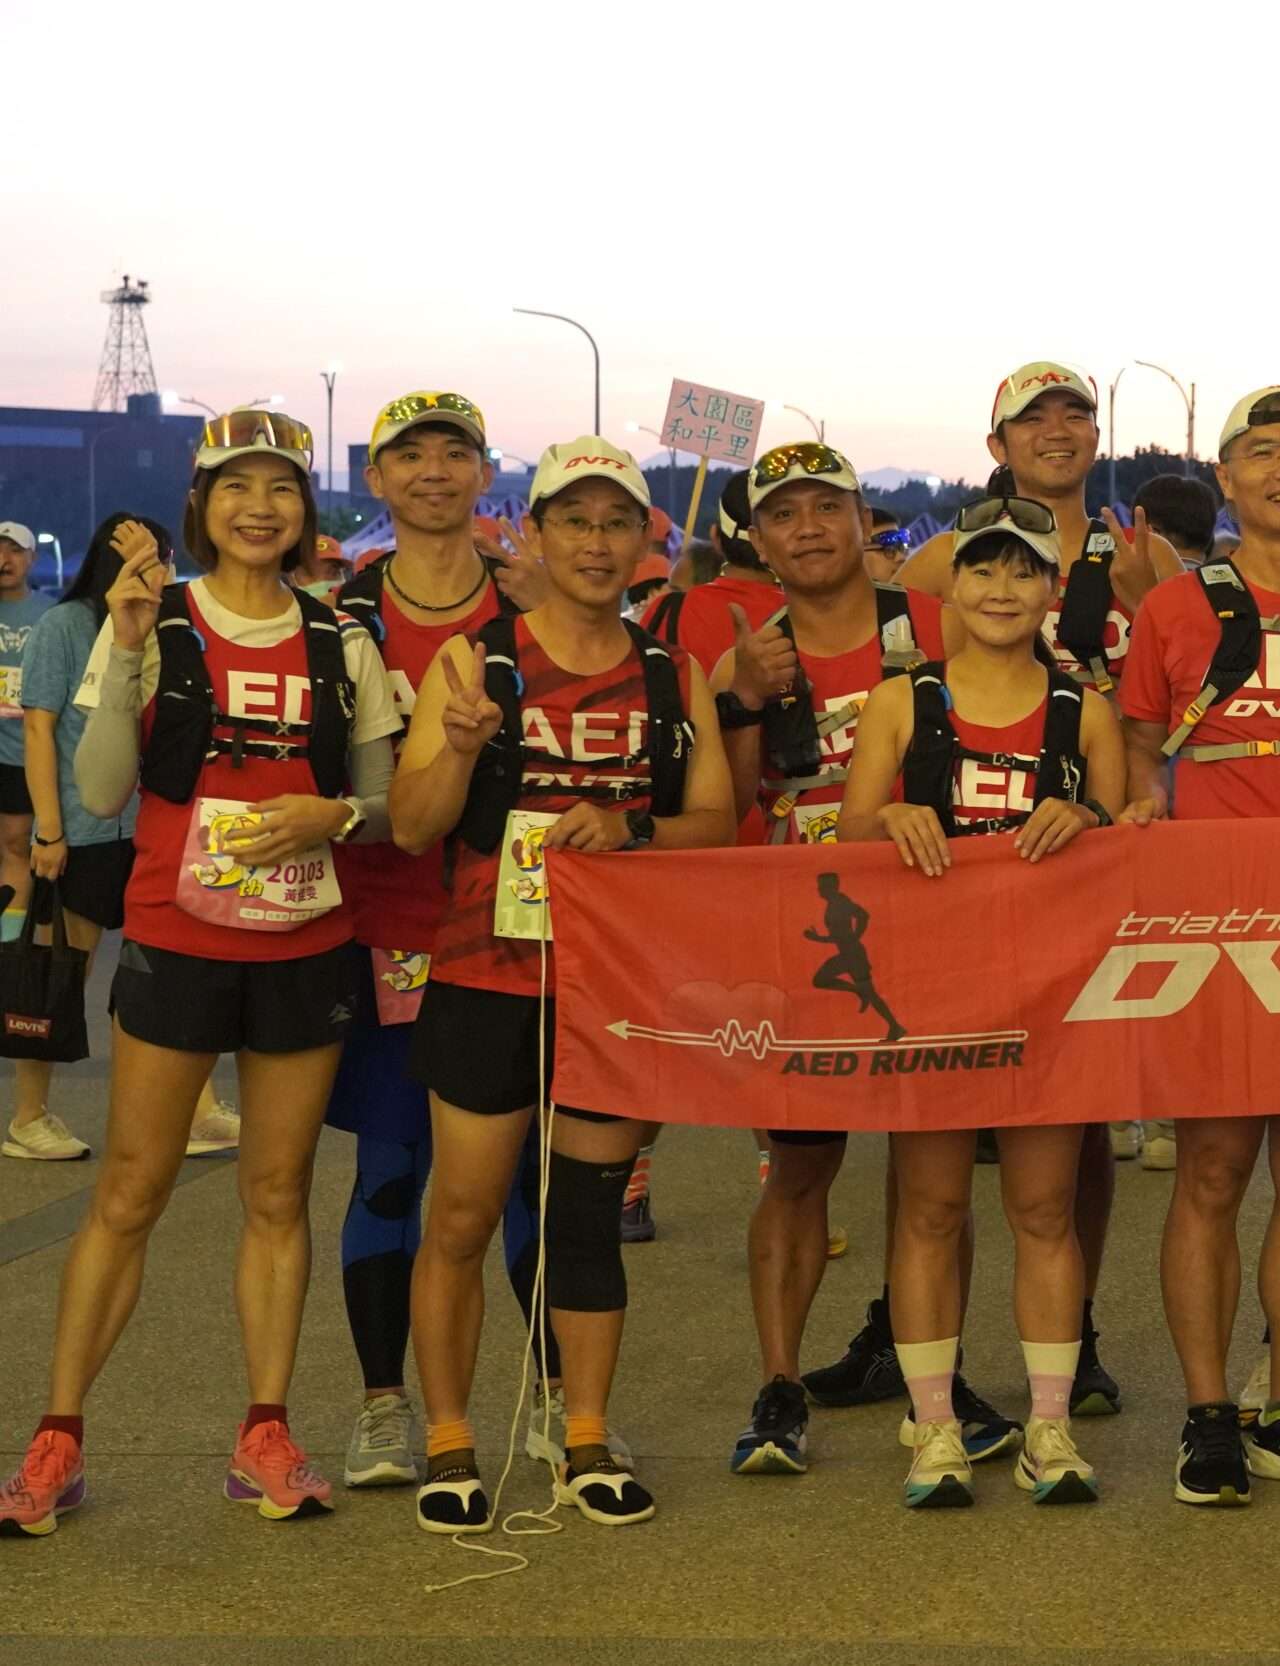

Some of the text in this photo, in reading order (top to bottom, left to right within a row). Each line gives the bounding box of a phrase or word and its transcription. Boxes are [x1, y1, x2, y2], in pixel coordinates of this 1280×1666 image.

[674, 388, 756, 432] 大園區
[667, 416, 750, 460] 和平里
[564, 456, 629, 471] DVTT
[266, 860, 324, 884] 20103
[782, 1043, 1025, 1077] AED RUNNER
